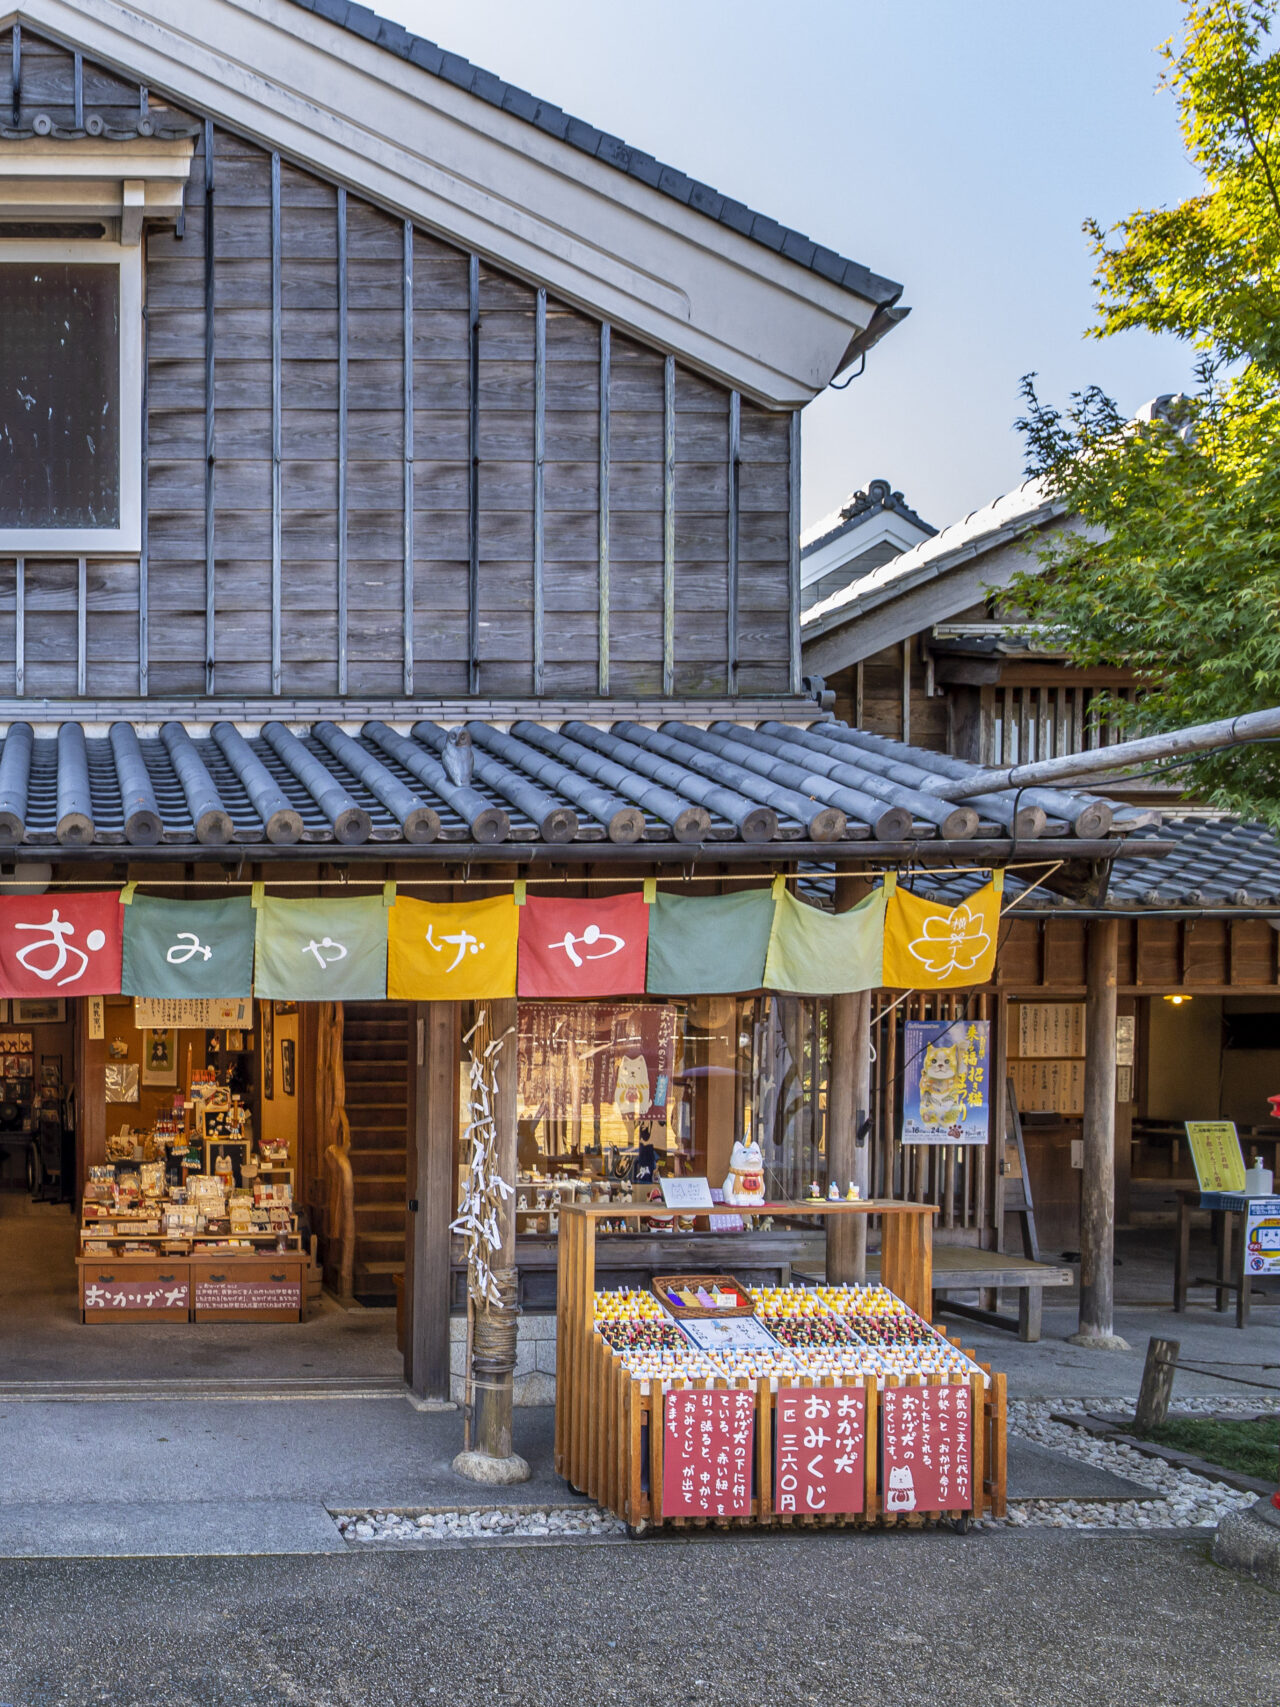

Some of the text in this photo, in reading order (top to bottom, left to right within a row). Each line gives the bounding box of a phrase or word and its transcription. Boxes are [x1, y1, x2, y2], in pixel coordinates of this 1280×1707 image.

[667, 1394, 678, 1438] きます。
[733, 1392, 753, 1509] おかげ犬の下に付い
[783, 1399, 798, 1422] 一匹
[834, 1394, 863, 1474] おかげ犬
[885, 1391, 897, 1460] おみくじです。
[901, 1394, 919, 1459] おかげ犬の
[921, 1389, 933, 1470] をしたとされる、
[956, 1388, 969, 1501] 病気のご主人に代わり、
[803, 1394, 831, 1509] おみくじ
